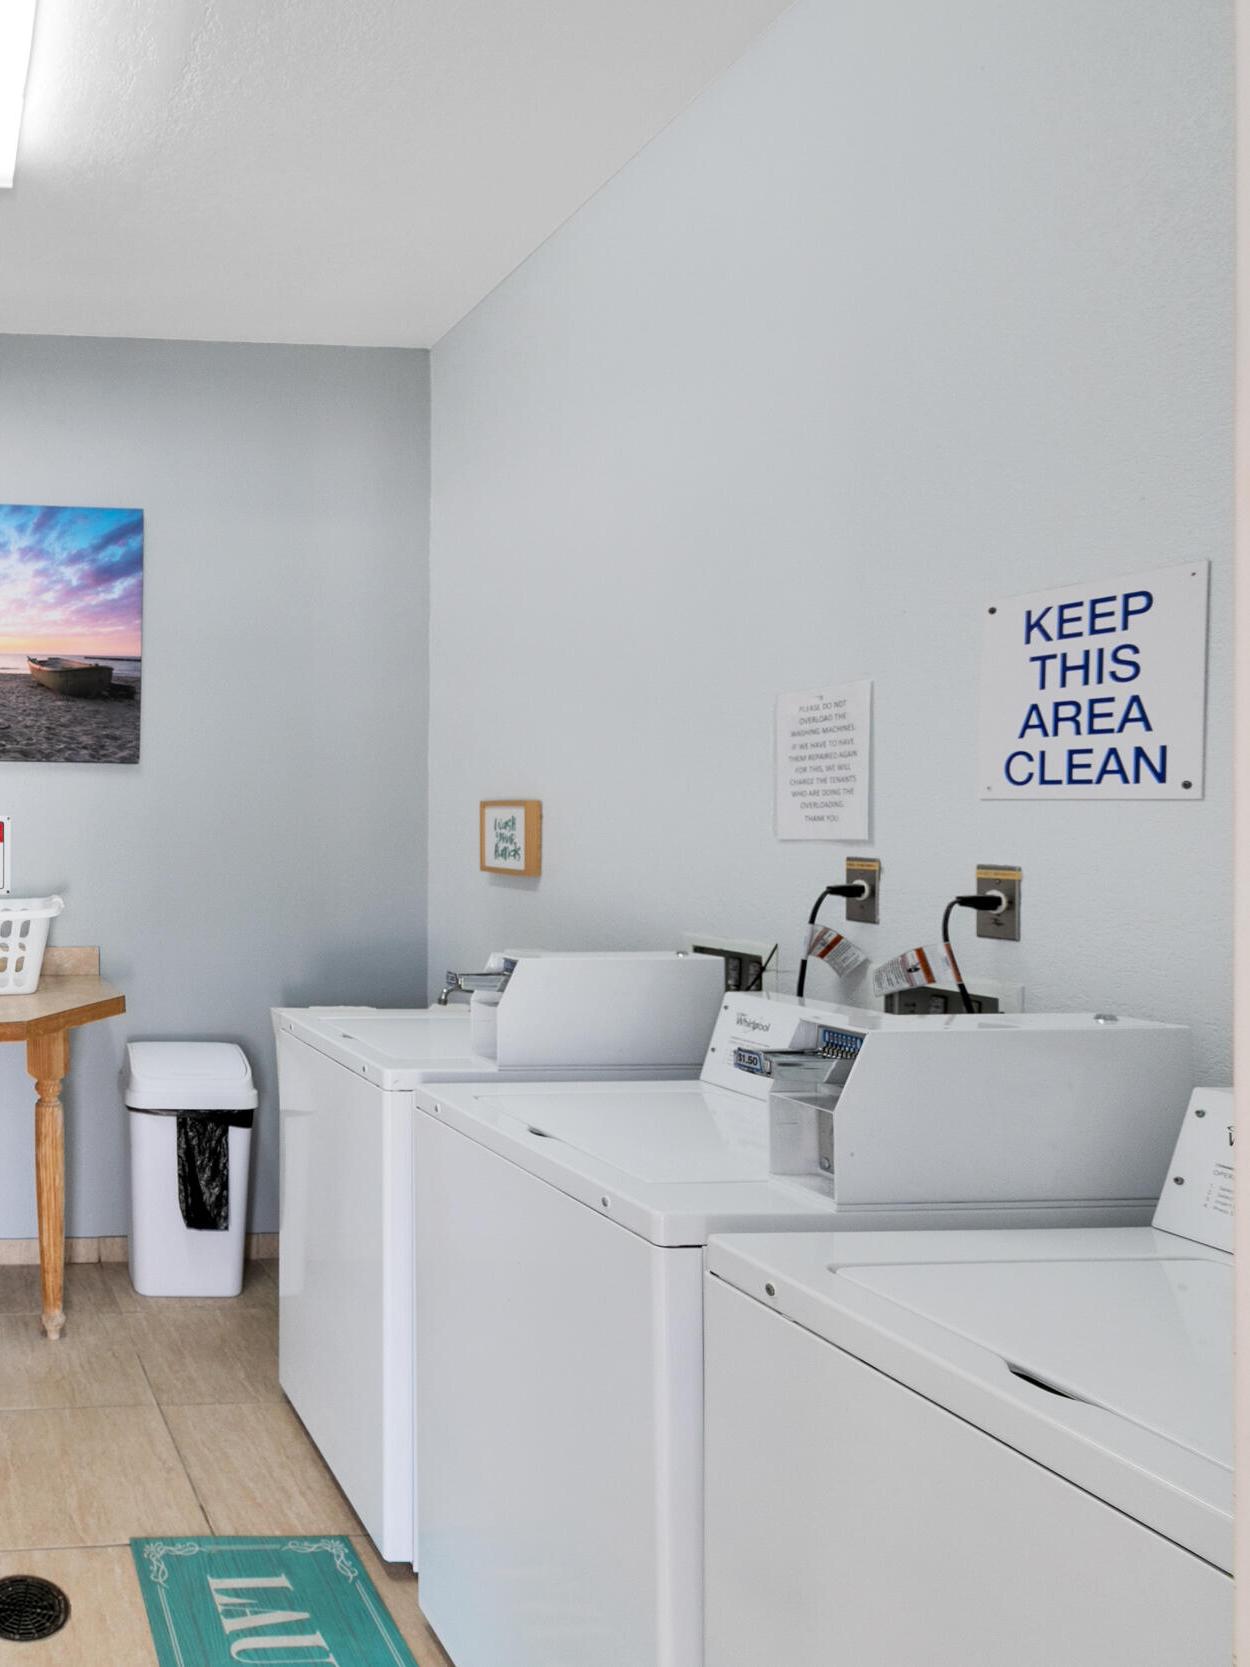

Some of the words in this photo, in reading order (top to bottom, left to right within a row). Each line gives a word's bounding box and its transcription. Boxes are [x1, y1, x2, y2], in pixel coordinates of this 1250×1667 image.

[1024, 590, 1154, 645] KEEP
[1029, 643, 1141, 691] THIS
[1017, 694, 1153, 739] AREA
[1004, 745, 1168, 787] CLEAN
[736, 1016, 770, 1032] Whirlpool
[738, 1053, 758, 1066] $1.50
